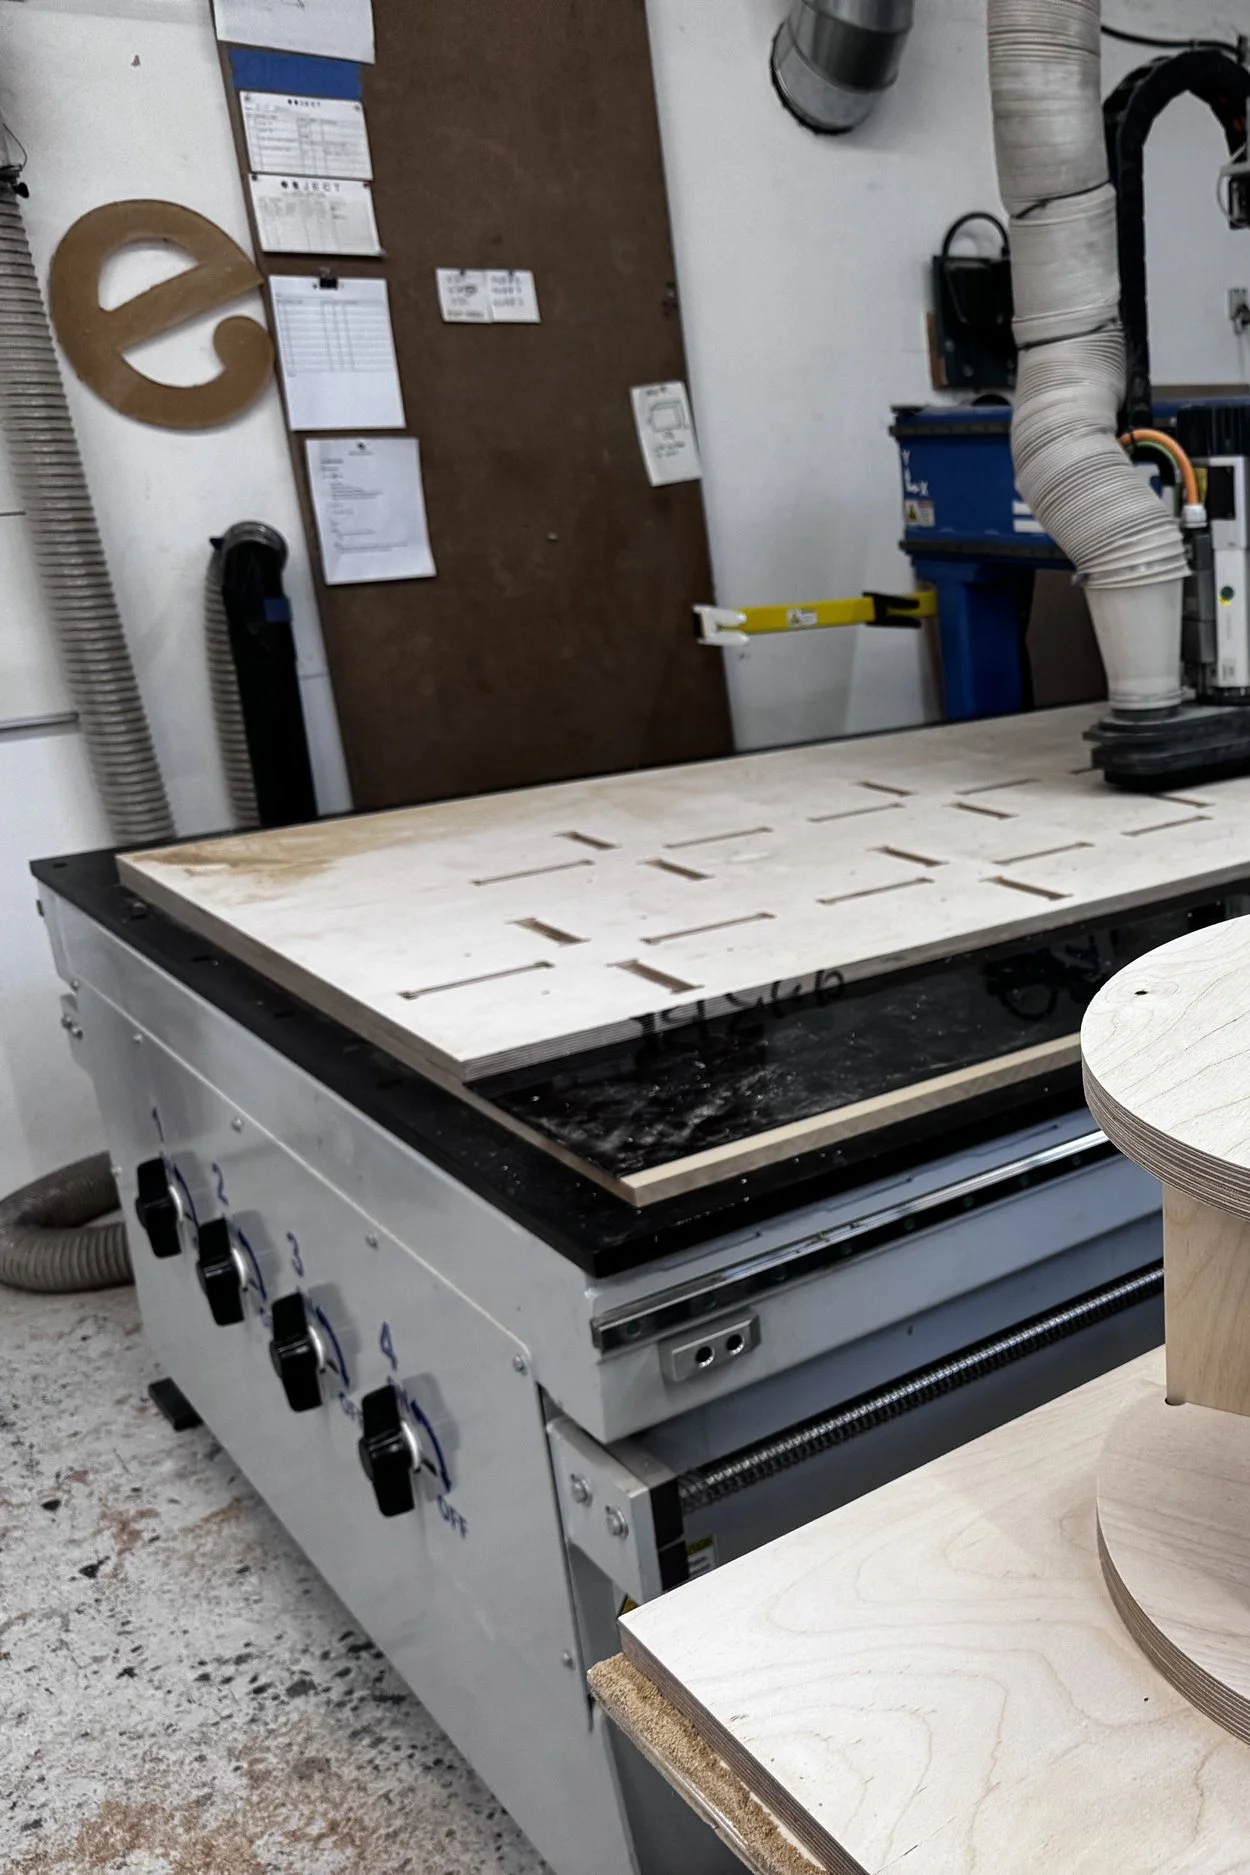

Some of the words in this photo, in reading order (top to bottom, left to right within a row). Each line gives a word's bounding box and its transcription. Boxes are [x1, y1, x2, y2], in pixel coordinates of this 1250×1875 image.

[211, 1162, 230, 1206] 2
[286, 1230, 305, 1278] 3
[380, 1321, 399, 1371] 4
[436, 1494, 469, 1540] OFF
